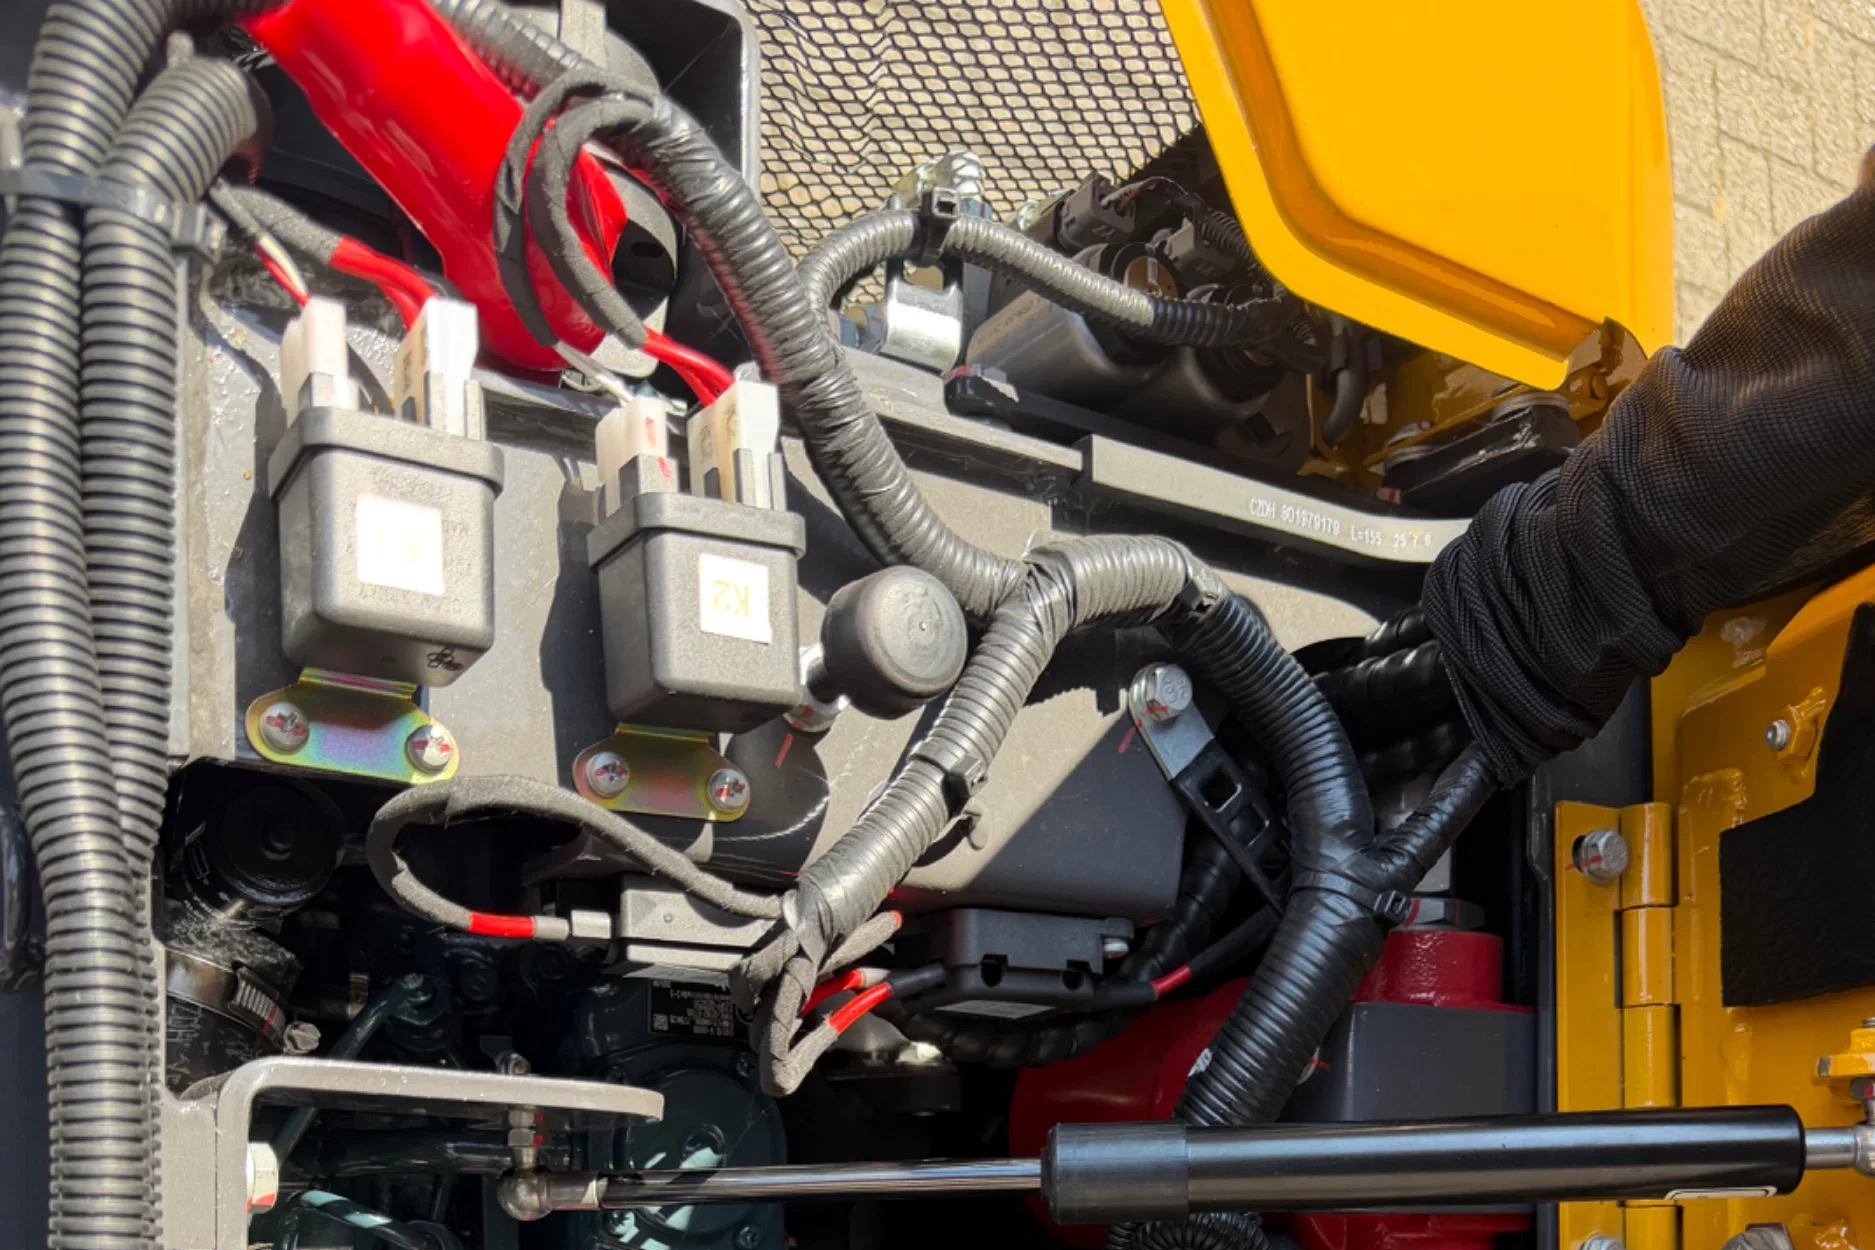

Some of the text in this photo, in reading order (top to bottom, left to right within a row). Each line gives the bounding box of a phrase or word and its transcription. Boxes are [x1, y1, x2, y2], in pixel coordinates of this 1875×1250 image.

[1250, 498, 1276, 519] CZDH
[1351, 525, 1382, 546] L=155
[712, 580, 750, 618] K2
